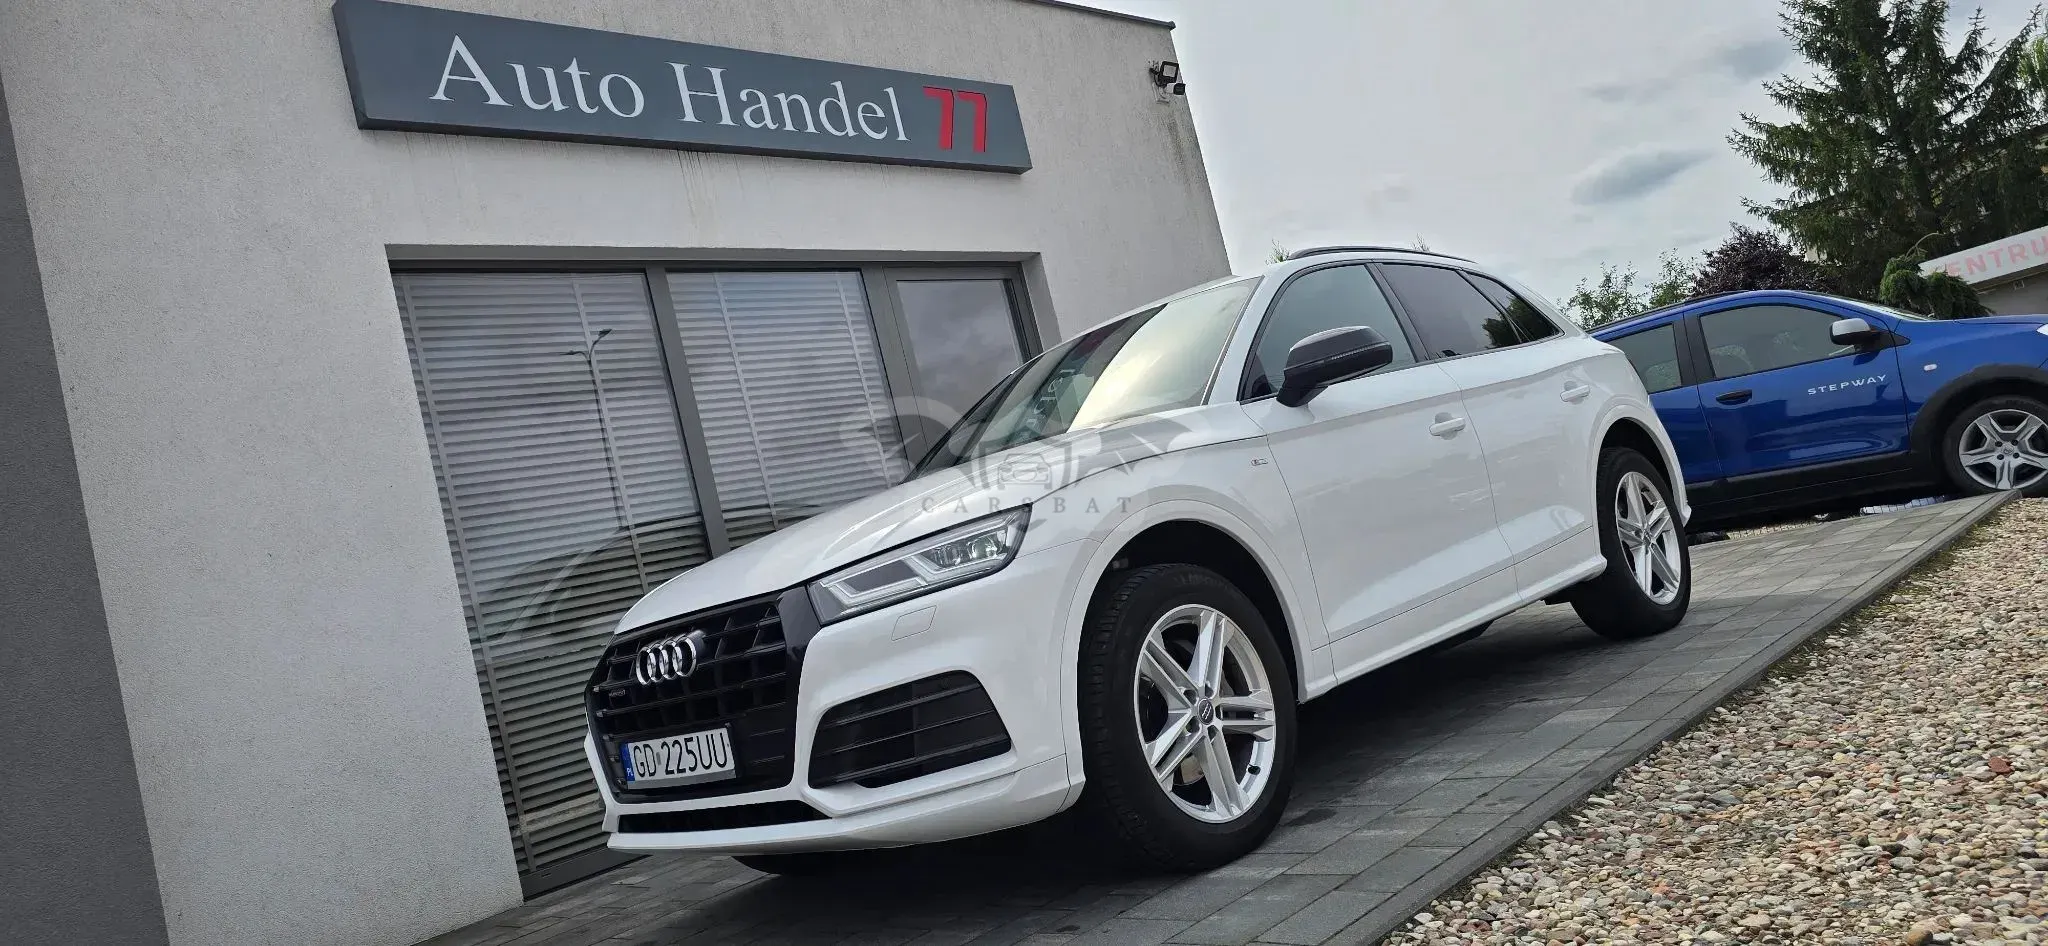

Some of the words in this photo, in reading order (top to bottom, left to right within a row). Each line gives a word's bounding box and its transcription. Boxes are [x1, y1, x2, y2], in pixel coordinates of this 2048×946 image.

[430, 34, 644, 119] Auto
[664, 60, 911, 142] Handel
[922, 86, 987, 153] 77
[1945, 235, 2048, 279] ENTRU
[1807, 374, 1886, 395] STEPWAY
[633, 745, 656, 777] GD
[661, 732, 727, 775] 225UU
